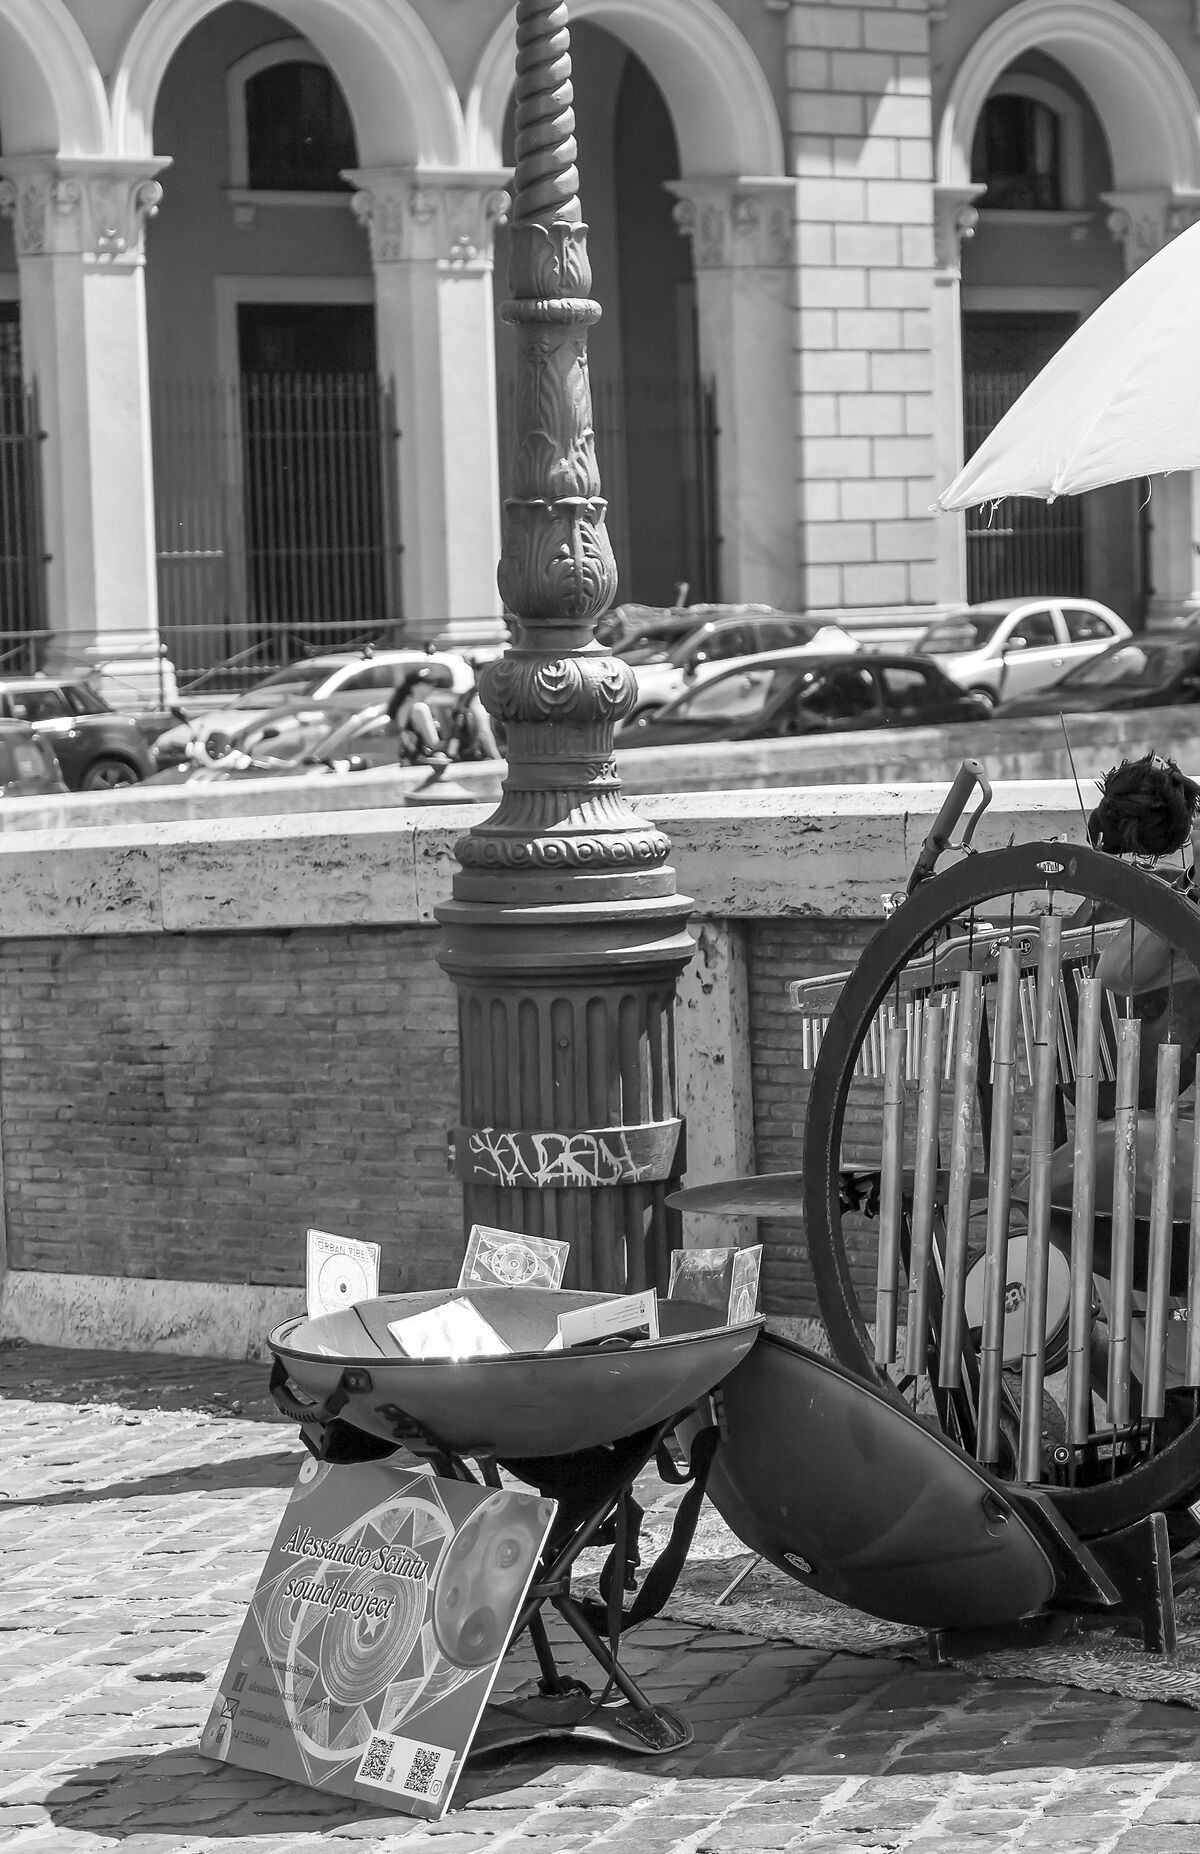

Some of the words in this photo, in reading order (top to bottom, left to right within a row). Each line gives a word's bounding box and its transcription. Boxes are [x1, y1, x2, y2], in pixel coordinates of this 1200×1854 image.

[281, 1525, 371, 1568] Alessandro
[372, 1544, 429, 1581] Scintu
[284, 1578, 340, 1606] sound
[330, 1587, 397, 1620] project
